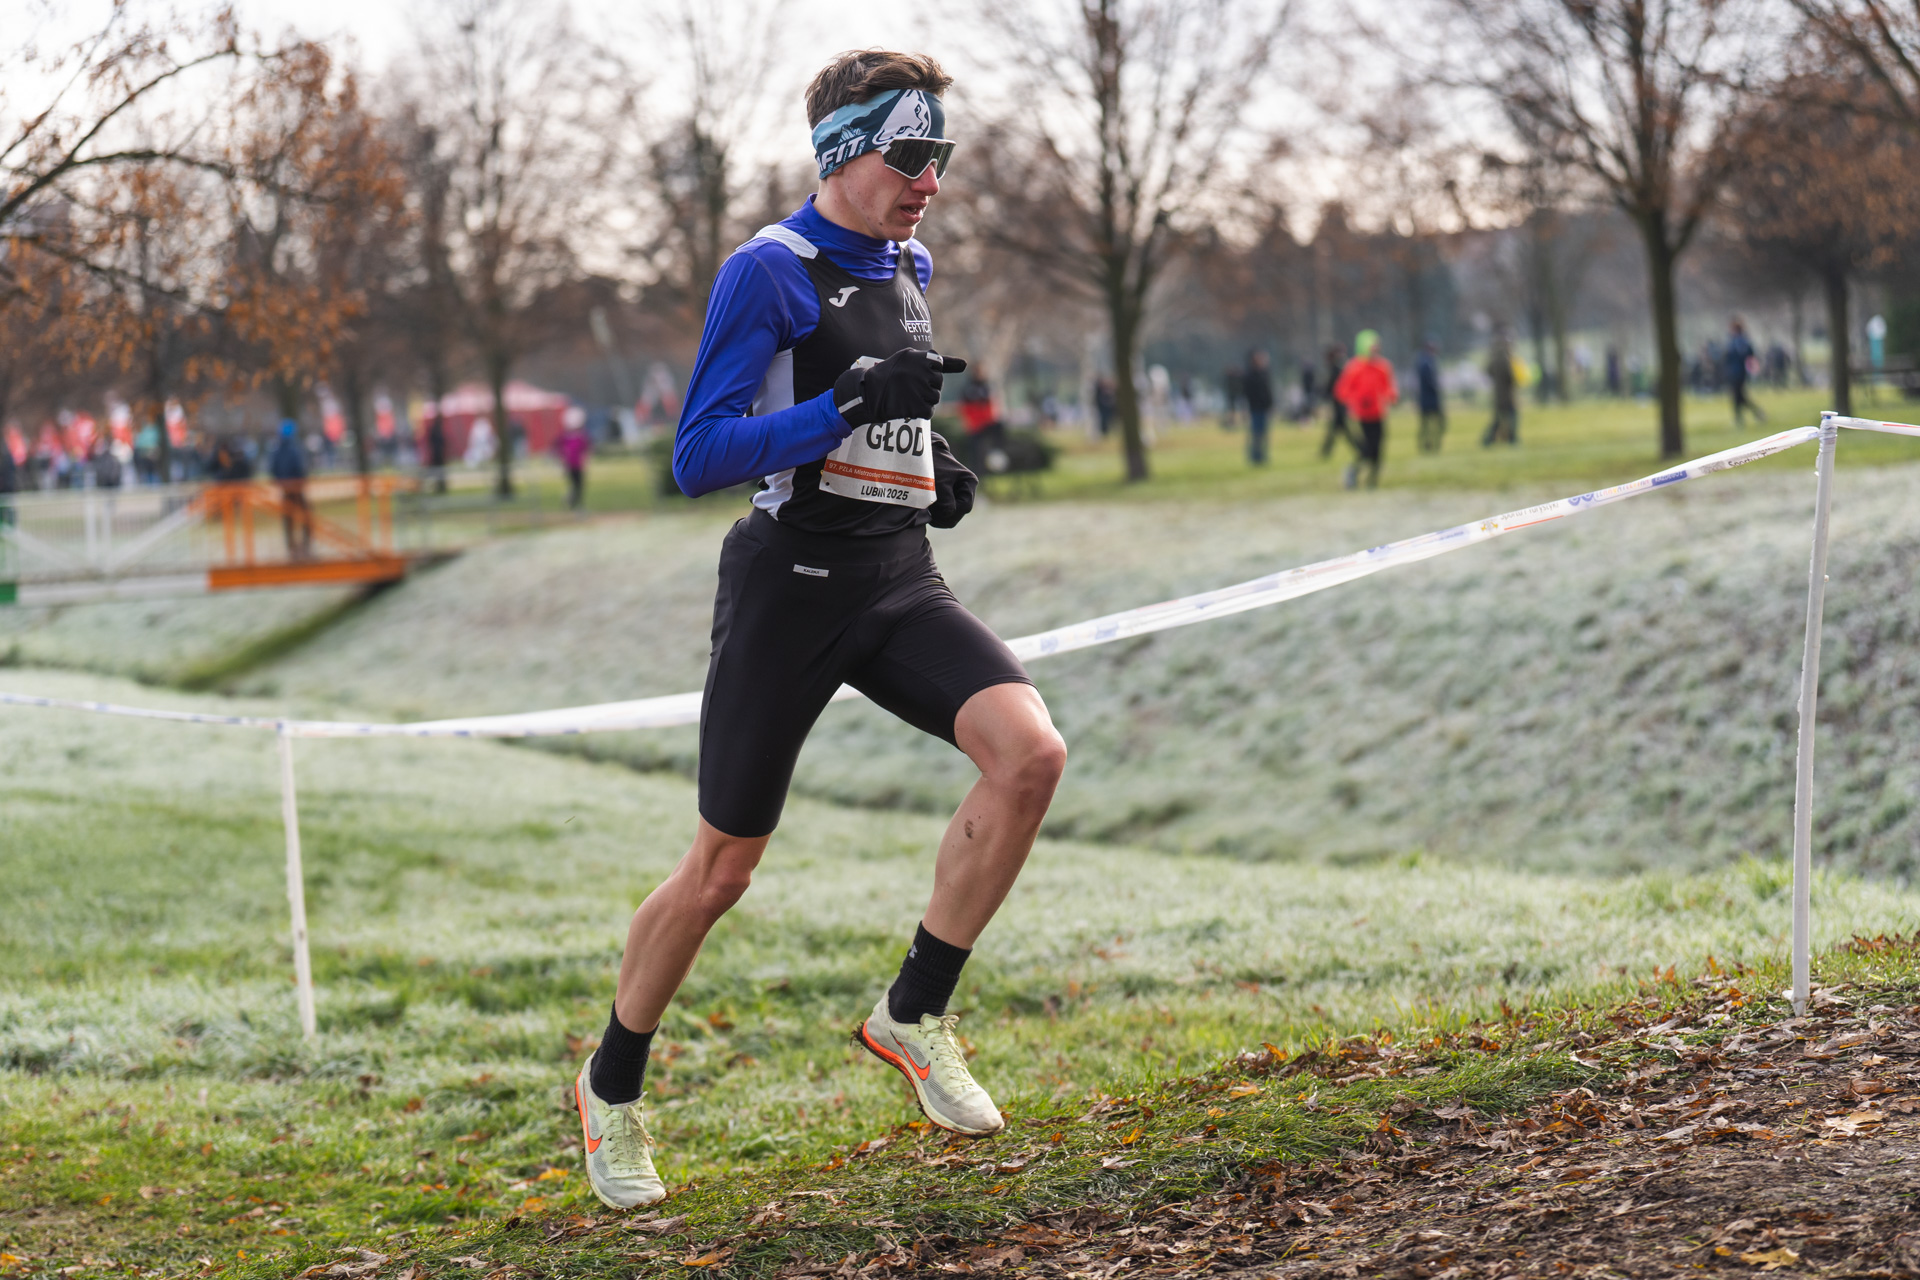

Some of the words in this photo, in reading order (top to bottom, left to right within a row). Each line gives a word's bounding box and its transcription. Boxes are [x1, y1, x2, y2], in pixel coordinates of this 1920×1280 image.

[816, 135, 866, 171] FIT
[866, 418, 925, 456] GŁÓD
[861, 485, 886, 498] LUBIN
[886, 488, 909, 500] 2025
